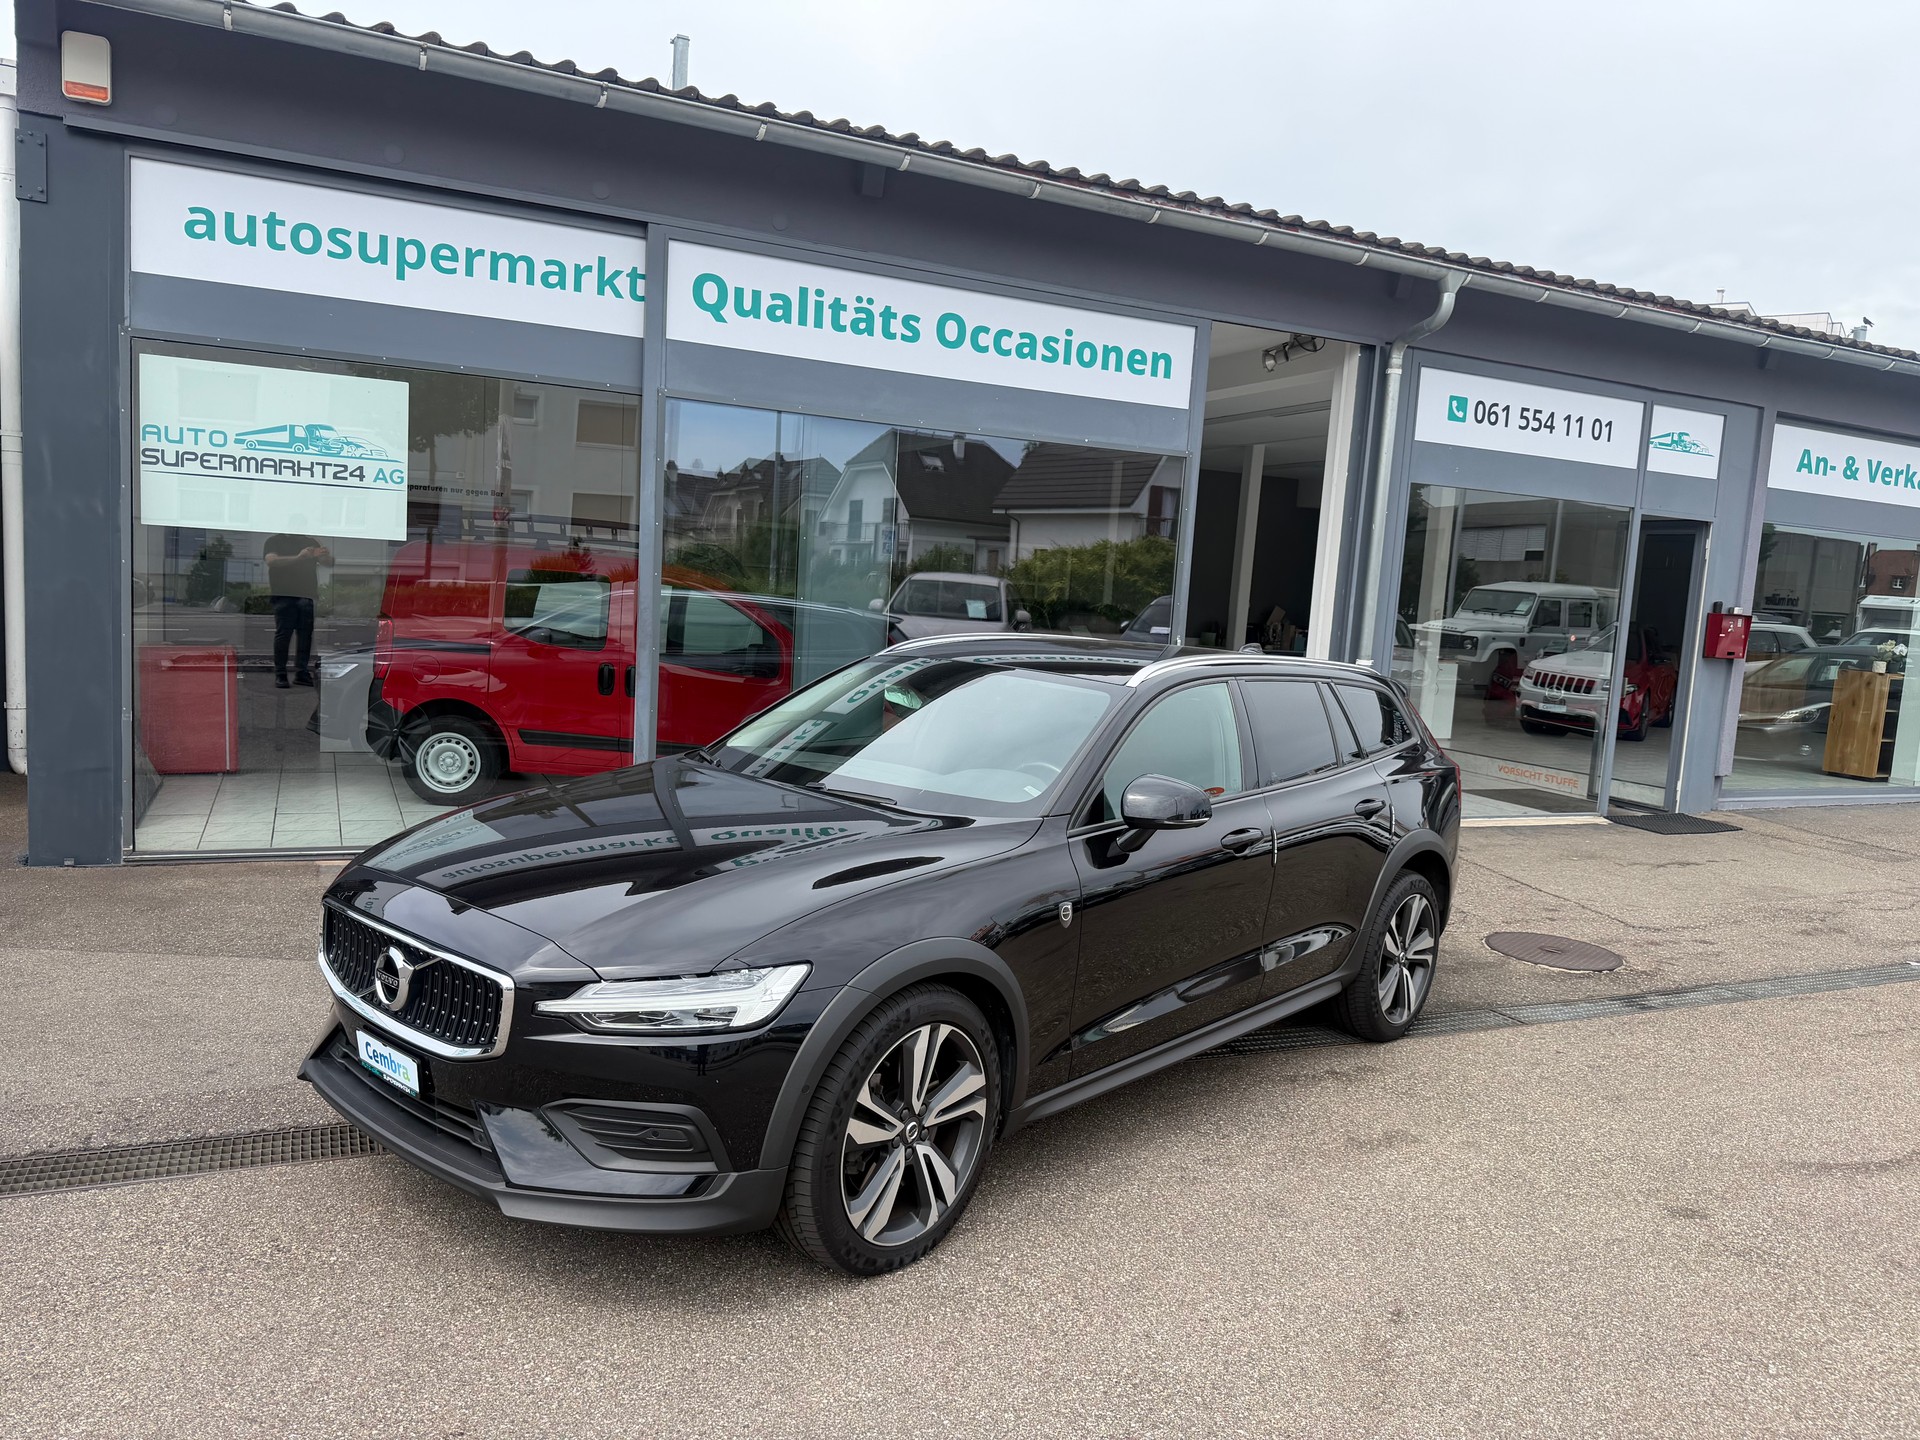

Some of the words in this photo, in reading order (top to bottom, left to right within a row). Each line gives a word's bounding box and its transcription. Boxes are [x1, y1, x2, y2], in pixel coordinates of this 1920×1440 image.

[184, 206, 646, 303] autosupermarkt
[692, 272, 921, 344] Qualitäts
[936, 312, 1172, 380] Occasionen
[142, 424, 228, 448] AUTO
[1474, 400, 1511, 428] 061
[1518, 407, 1556, 434] 554
[1563, 414, 1584, 438] 11
[1591, 418, 1613, 443] 01
[141, 447, 366, 482] SUPERMARKT24
[373, 467, 406, 485] AG
[1796, 448, 1837, 477] An-
[1842, 455, 1860, 481] &
[1867, 458, 1920, 490] Verk
[465, 489, 489, 497] gegen
[491, 489, 504, 497] Bar
[1497, 764, 1543, 781] VORSICHT
[377, 970, 399, 987] VOLVO
[365, 1041, 411, 1083] Cembra
